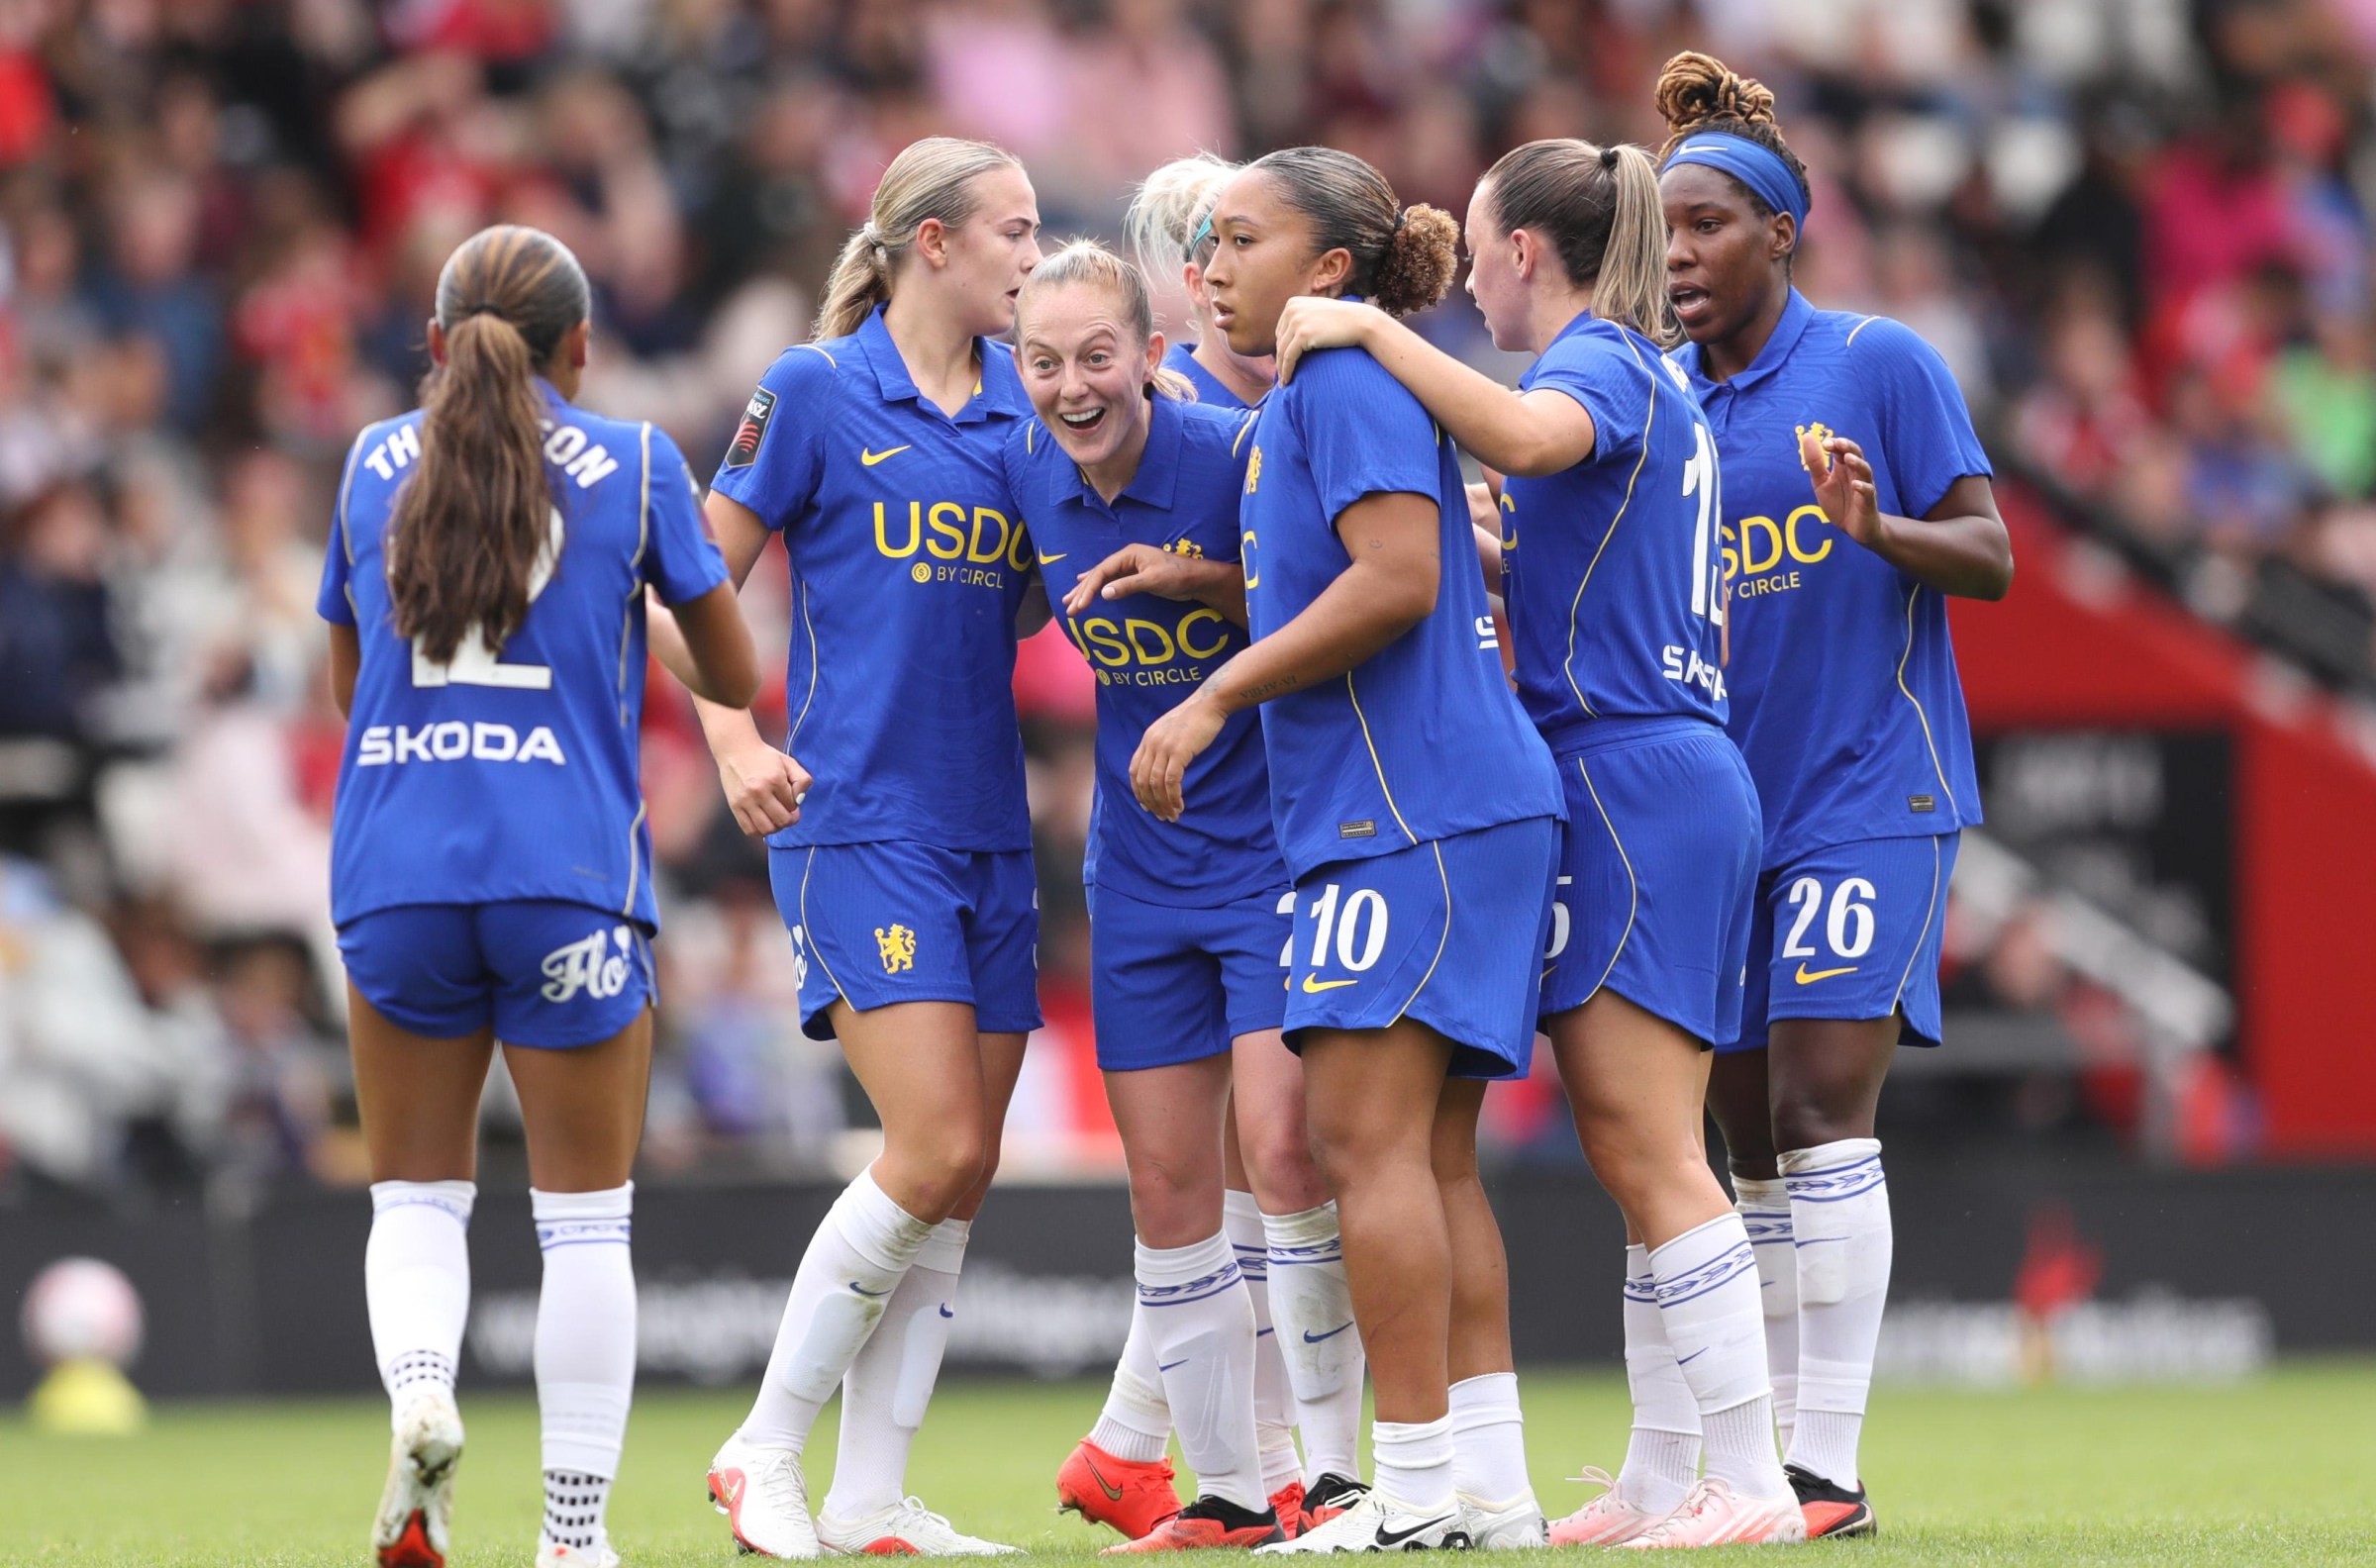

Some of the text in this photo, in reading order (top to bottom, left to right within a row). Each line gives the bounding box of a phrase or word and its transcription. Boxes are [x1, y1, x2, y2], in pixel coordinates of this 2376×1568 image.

[363, 423, 619, 489] THON
[872, 501, 1034, 572] USDC
[937, 566, 957, 582] BY
[1738, 571, 1802, 600] CIRCLE
[1112, 666, 1203, 687] BY CIRCLE
[356, 720, 567, 767] SKODA
[1309, 883, 1389, 972] 10
[1781, 876, 1878, 960] 26
[540, 925, 633, 1004] Flo
